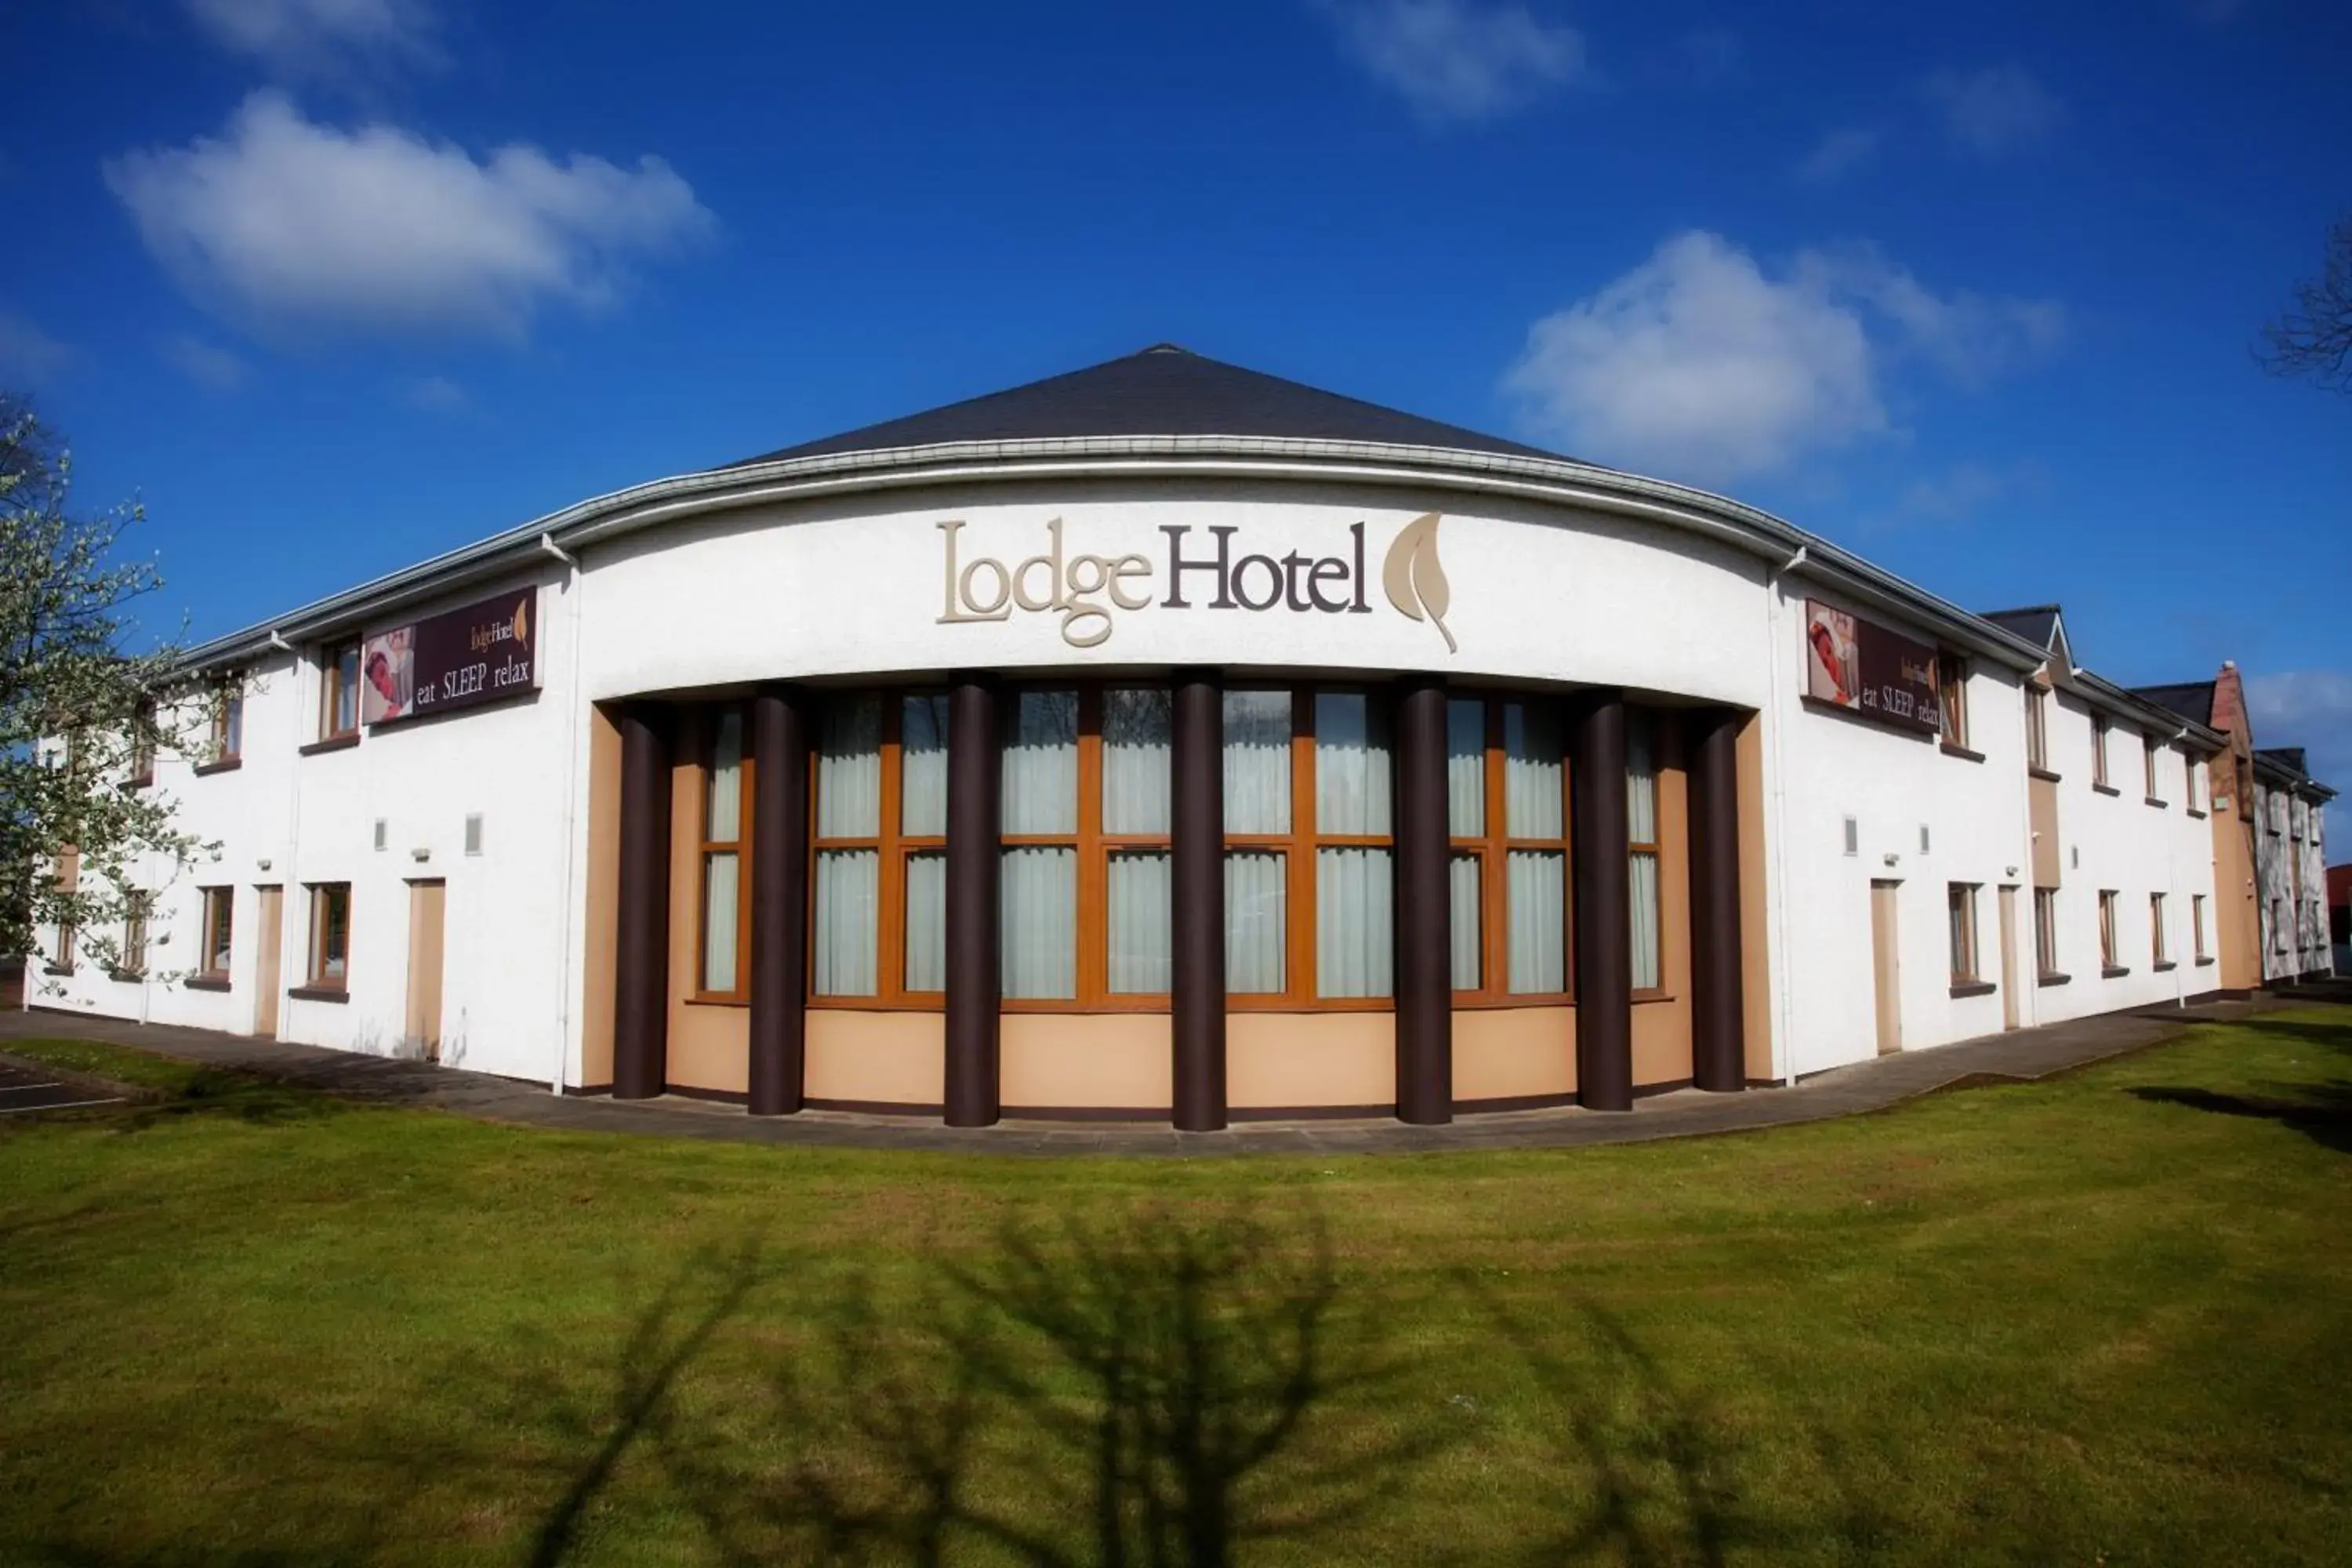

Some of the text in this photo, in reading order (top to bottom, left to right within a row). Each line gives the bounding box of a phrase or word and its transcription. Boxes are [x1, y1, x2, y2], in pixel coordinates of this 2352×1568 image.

[936, 517, 1373, 648] Lodge Hotel
[417, 655, 529, 706] eat SLEEP relax
[1882, 684, 1914, 718] SLEEP
